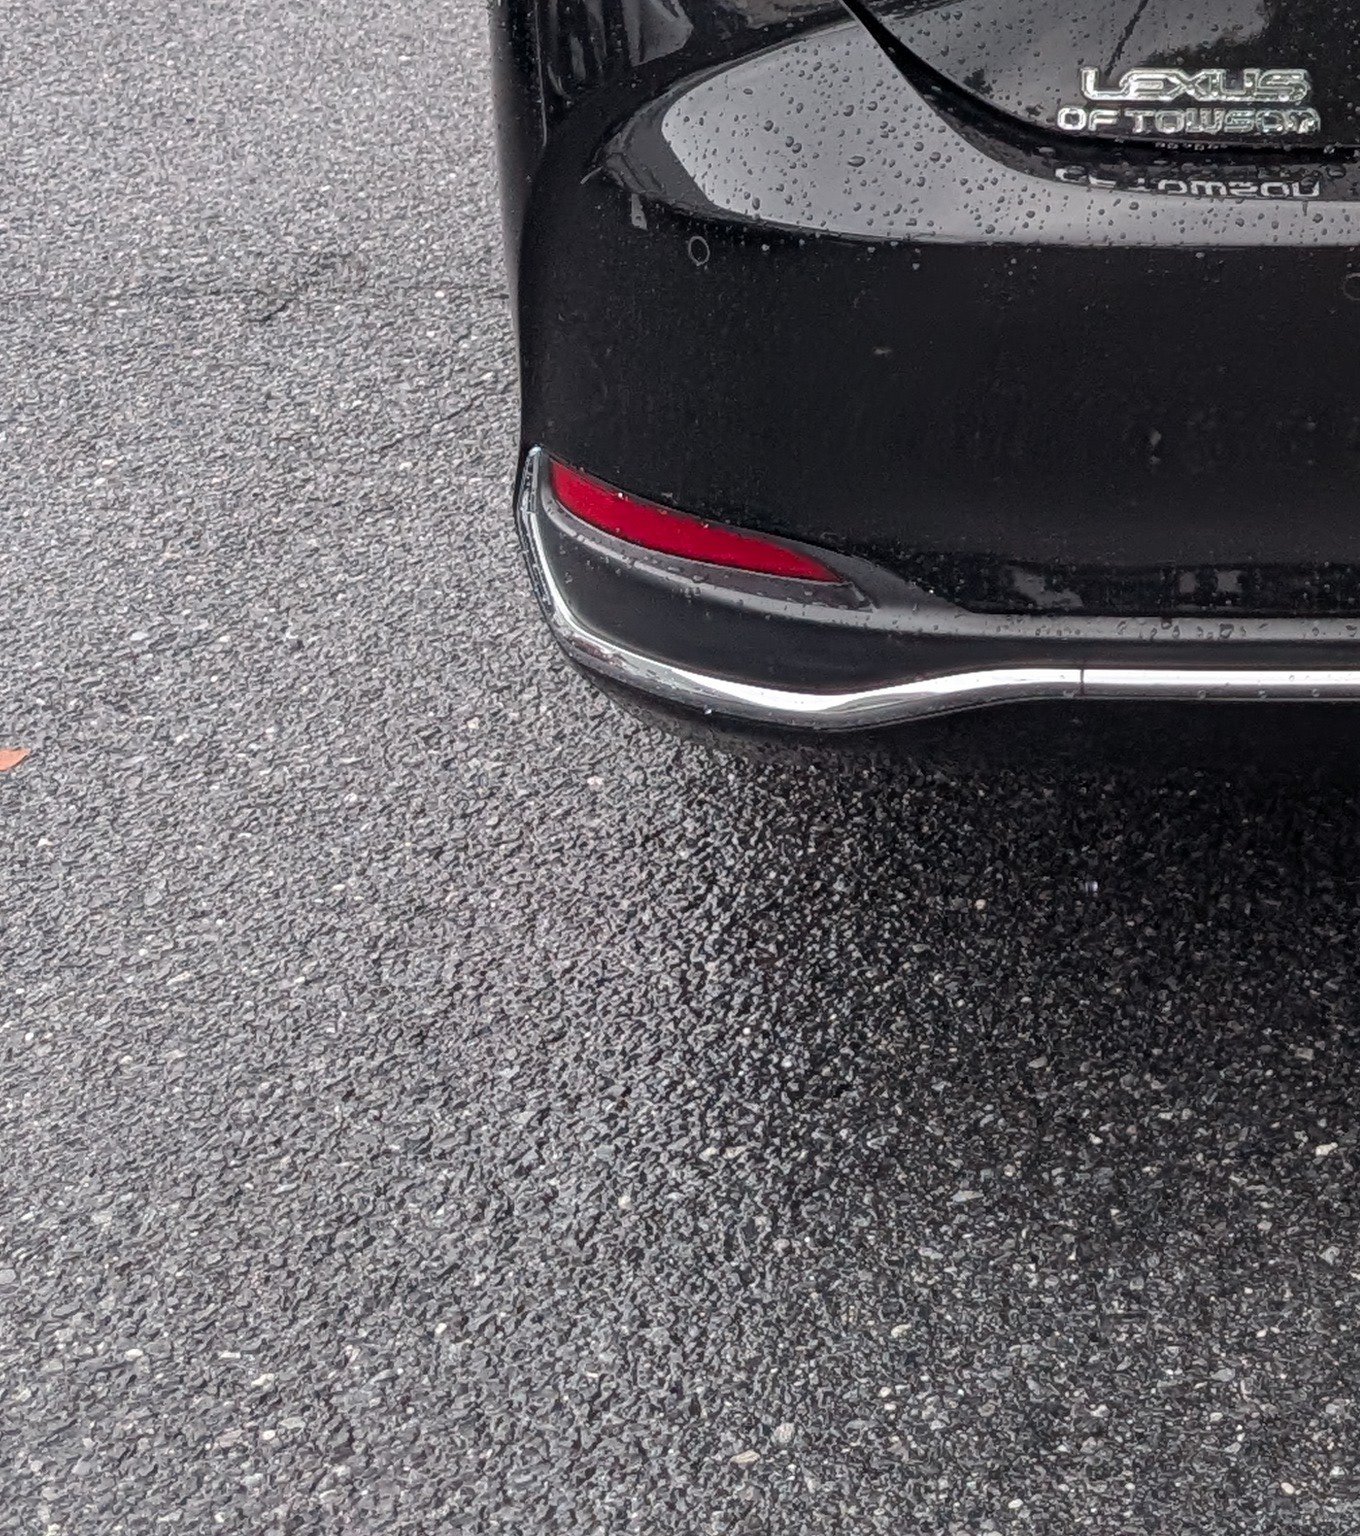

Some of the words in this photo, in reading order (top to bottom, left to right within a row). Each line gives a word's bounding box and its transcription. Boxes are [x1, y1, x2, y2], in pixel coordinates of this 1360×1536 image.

[1079, 66, 1311, 103] LEXUS
[1056, 107, 1118, 132] OF
[1124, 107, 1322, 135] TOWSON
